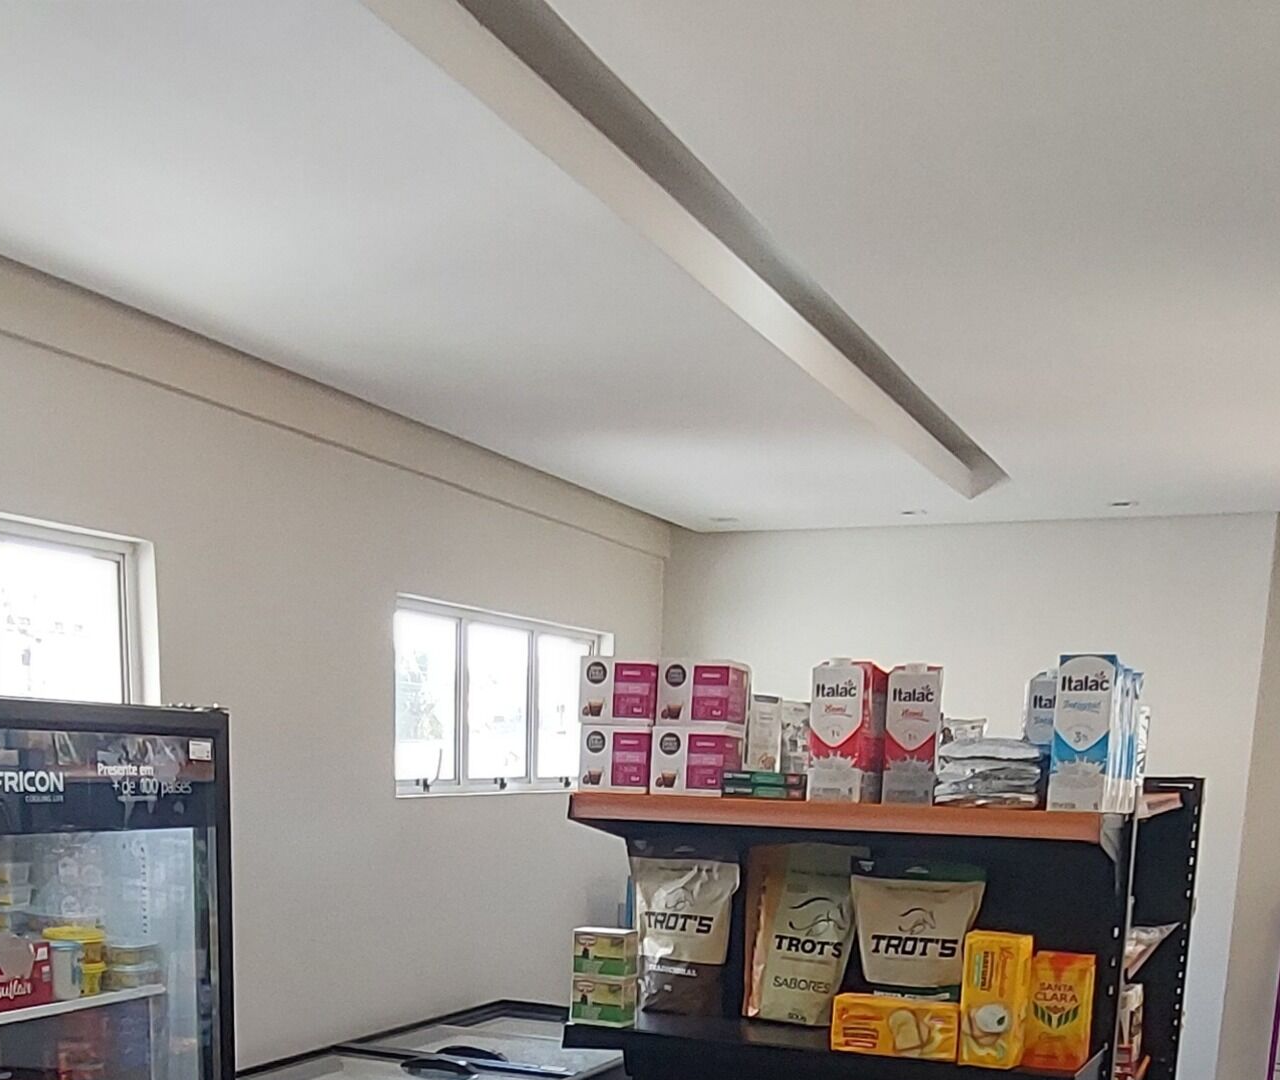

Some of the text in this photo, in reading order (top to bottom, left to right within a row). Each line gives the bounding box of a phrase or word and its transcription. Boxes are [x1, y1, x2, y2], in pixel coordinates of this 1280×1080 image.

[816, 683, 857, 698] Italac
[1061, 675, 1110, 692] Italac
[893, 687, 935, 702] Italac
[1033, 695, 1056, 709] Ital
[97, 763, 154, 777] Presente em
[121, 777, 136, 794] de
[645, 911, 713, 935] TROT'S
[775, 934, 843, 959] TROT'S
[871, 934, 959, 958] TROT'S
[773, 976, 831, 994] SABORES
[1040, 982, 1074, 992] SANTA
[1034, 991, 1078, 1003] CLARA
